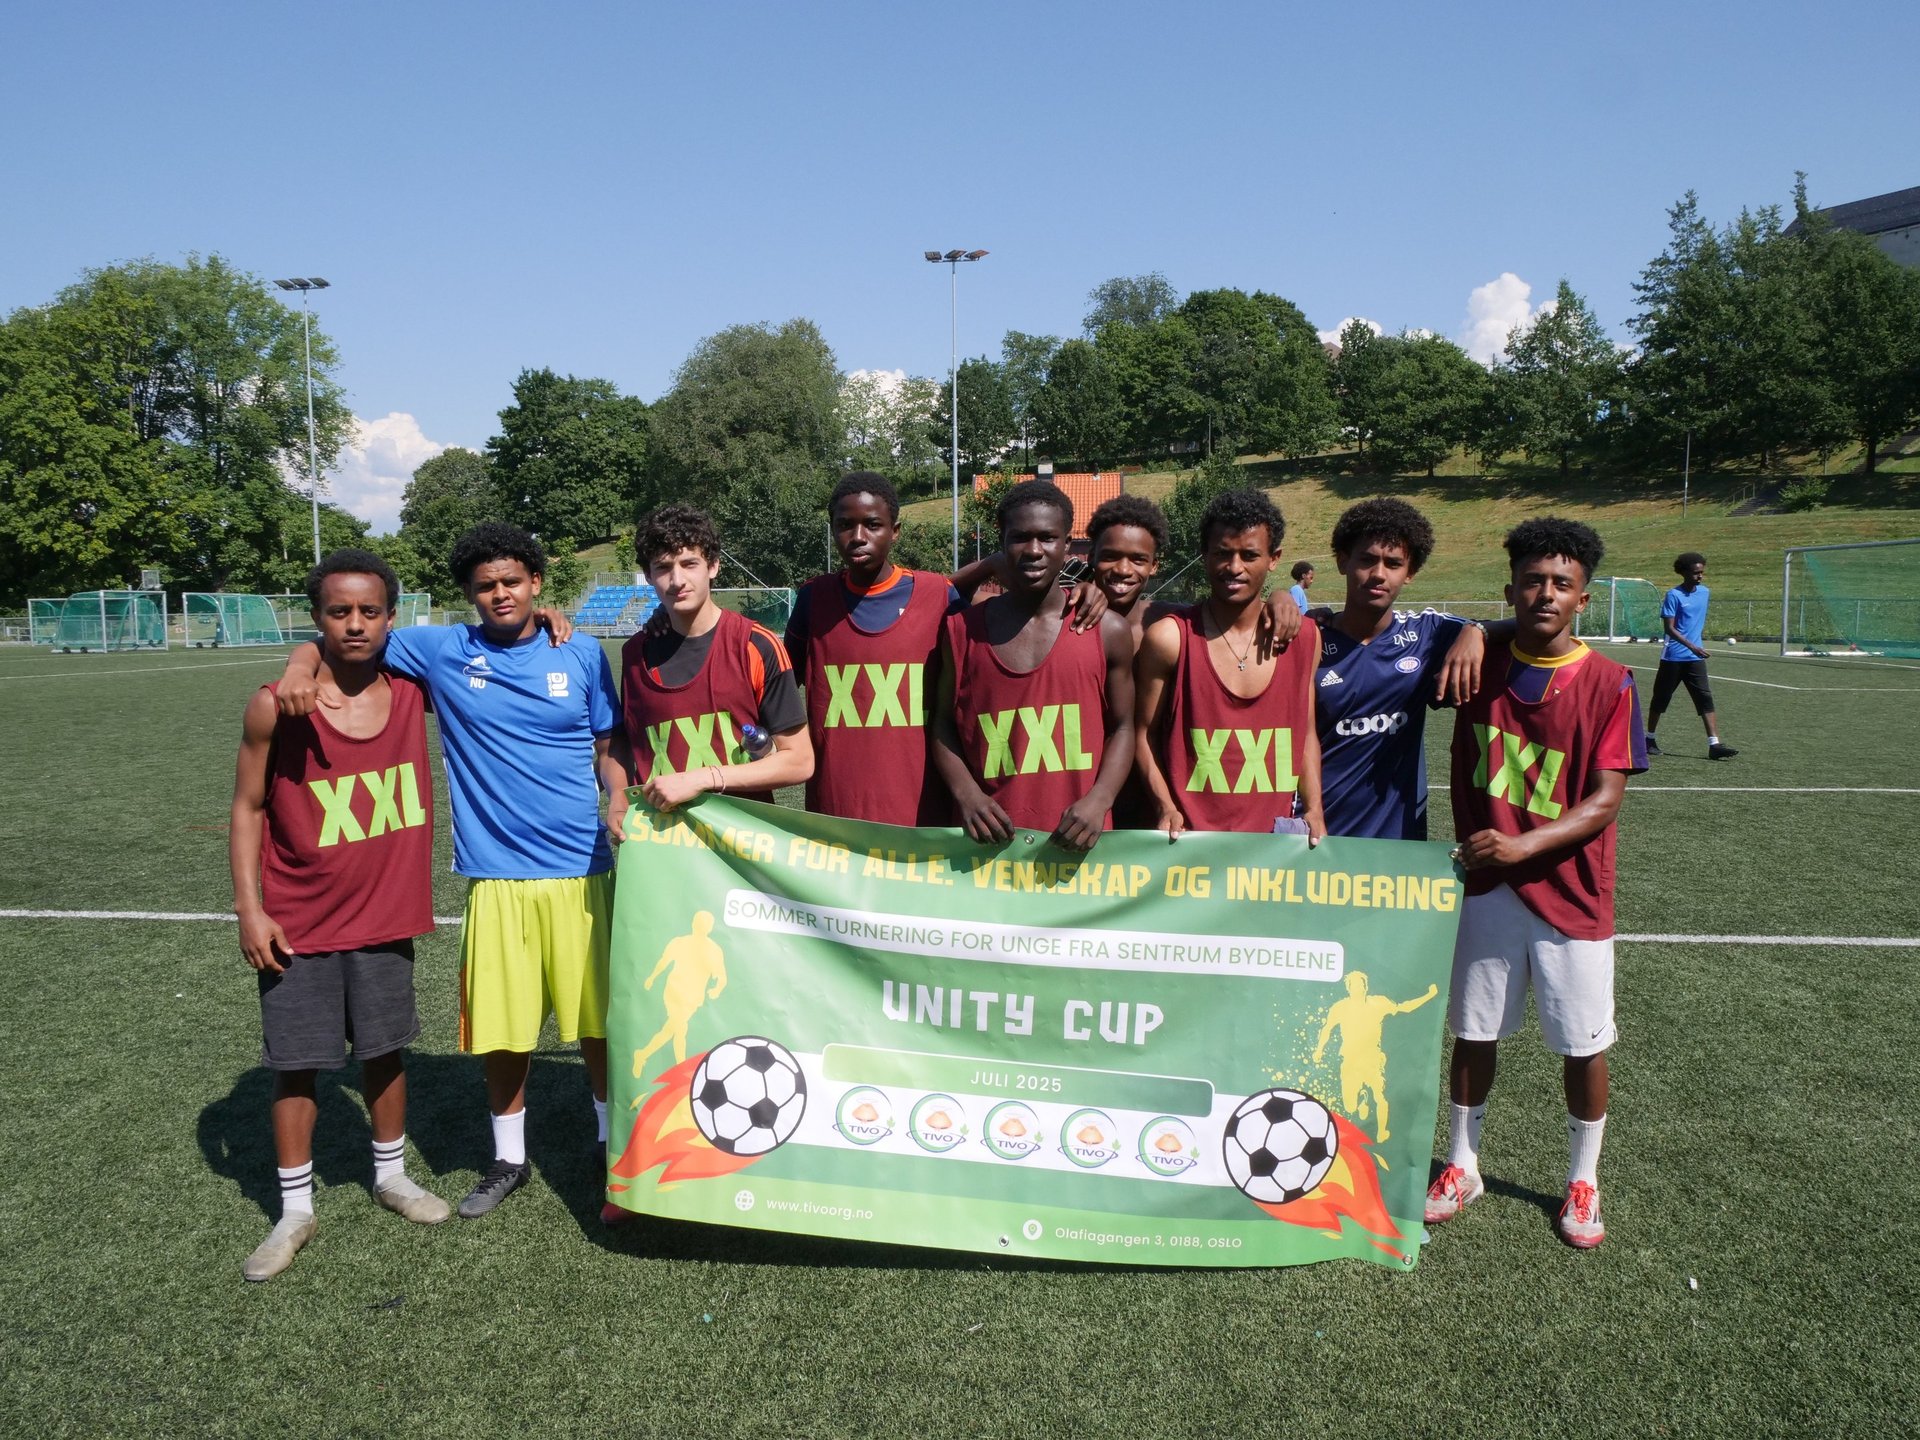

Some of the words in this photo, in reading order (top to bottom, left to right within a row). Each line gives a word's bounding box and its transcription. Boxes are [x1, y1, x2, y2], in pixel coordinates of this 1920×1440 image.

[1320, 642, 1338, 661] NB
[1320, 677, 1344, 688] adidas
[823, 663, 928, 728] XXL
[645, 711, 751, 785] XXL
[977, 703, 1093, 779] XXL
[1185, 727, 1299, 794] XXL
[1472, 723, 1566, 820] XXL
[308, 762, 426, 848] XXL
[786, 836, 850, 874] FOR
[862, 847, 954, 886] ALLE.
[971, 856, 1152, 898] VENNSKAP
[1164, 865, 1211, 898] OG
[1226, 866, 1457, 912] INKLUDERING
[727, 899, 818, 928] SOMMER
[823, 916, 944, 946] TURNERING
[951, 931, 994, 951] FOR
[1001, 935, 1061, 957] UNGE
[1069, 939, 1109, 959] FRA
[1117, 941, 1221, 964] SENTRUM
[1229, 947, 1336, 971] BYDELENE
[882, 979, 1035, 1036] UNITY
[1063, 999, 1164, 1045] CUP
[970, 1071, 1009, 1087] JULI
[1016, 1074, 1062, 1093] 2025
[849, 1124, 880, 1136] TIVO
[922, 1131, 954, 1143] TIVO
[996, 1139, 1028, 1150] TIVO
[1073, 1147, 1105, 1158] TIVO
[1152, 1155, 1184, 1166] TIVO
[766, 1199, 874, 1221] www.tivoorg.no
[1055, 1227, 1150, 1247] Olafiagangen
[1154, 1235, 1166, 1247] 3,
[1169, 1236, 1203, 1249] 0188,
[1207, 1237, 1242, 1249] OSLO
